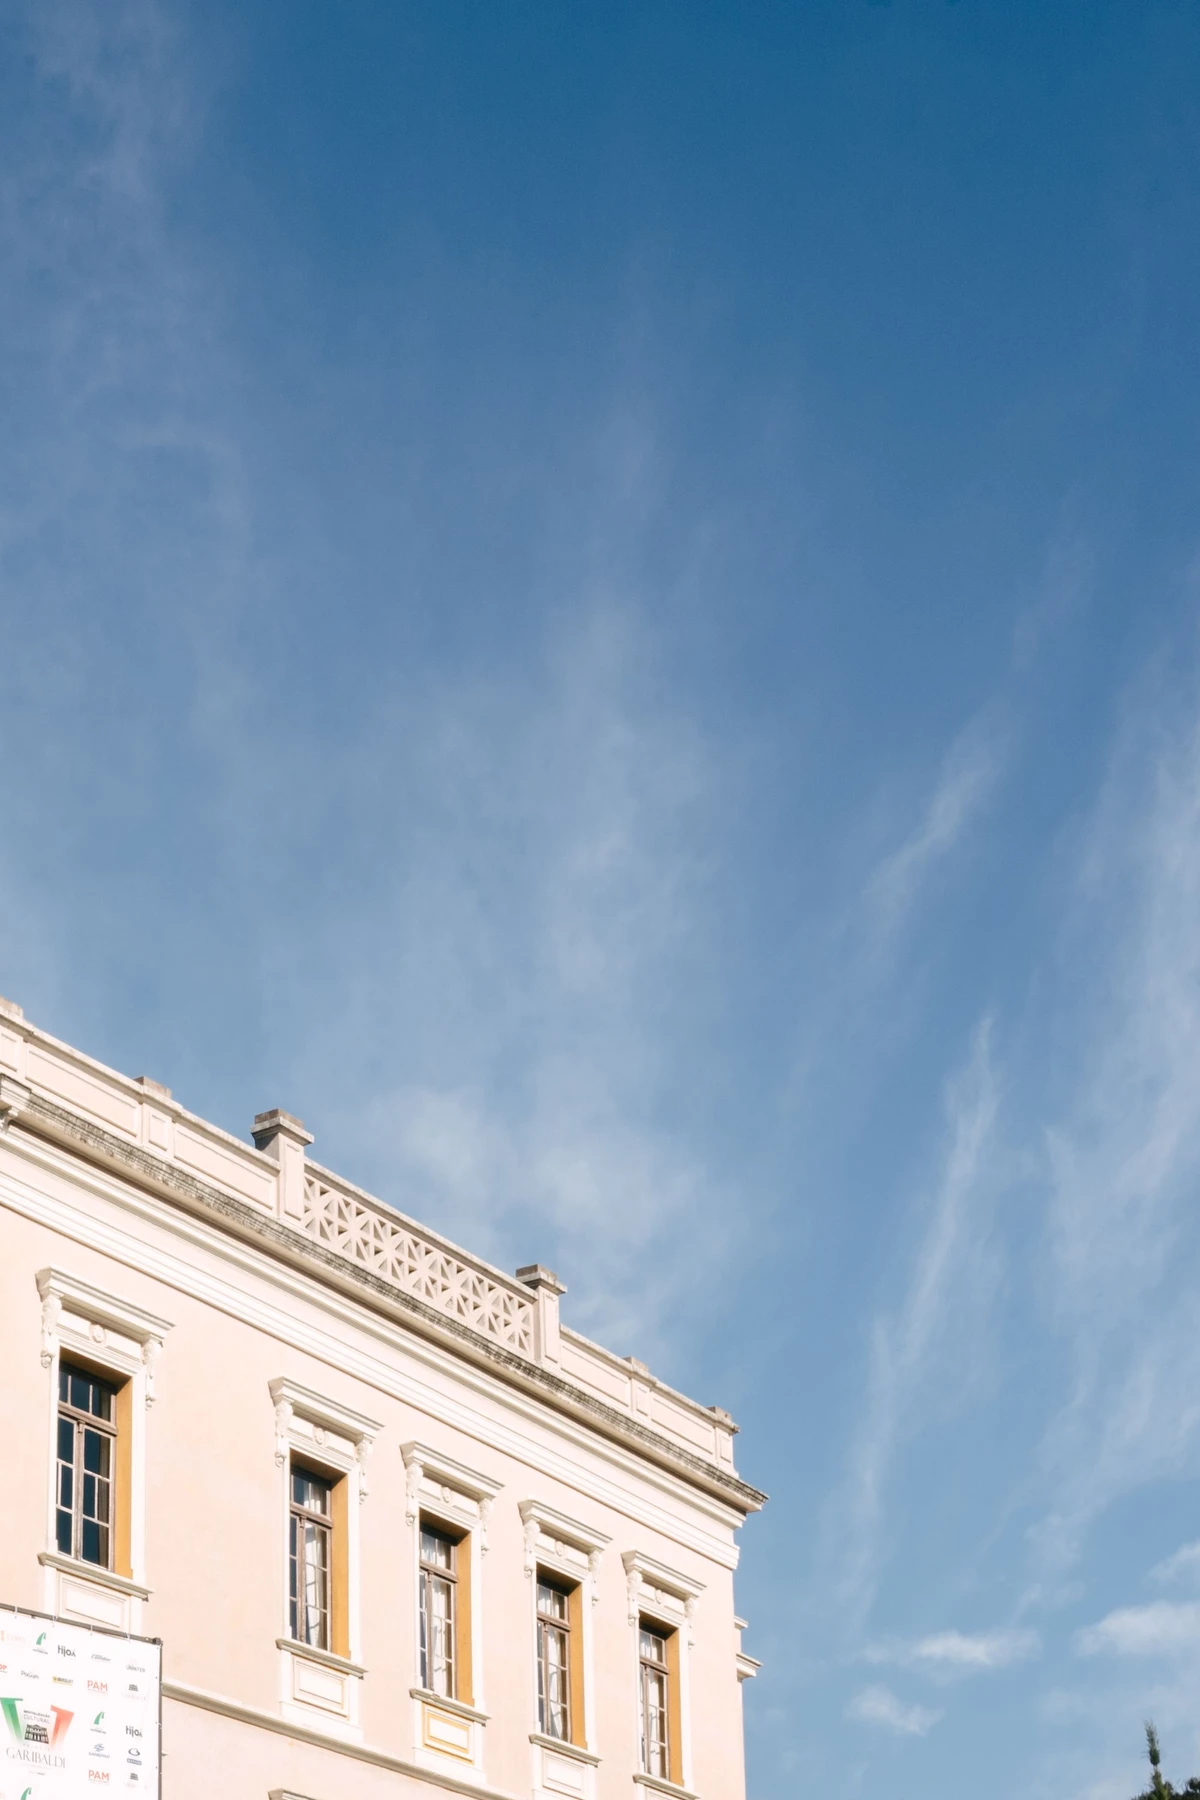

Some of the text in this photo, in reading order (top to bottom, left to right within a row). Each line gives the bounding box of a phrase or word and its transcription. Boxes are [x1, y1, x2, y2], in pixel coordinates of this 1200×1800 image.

[87, 1680, 108, 1692] PAM
[24, 1714, 50, 1724] CULTURAL
[6, 1747, 66, 1768] GARIBALDI
[88, 1770, 109, 1781] PAM
